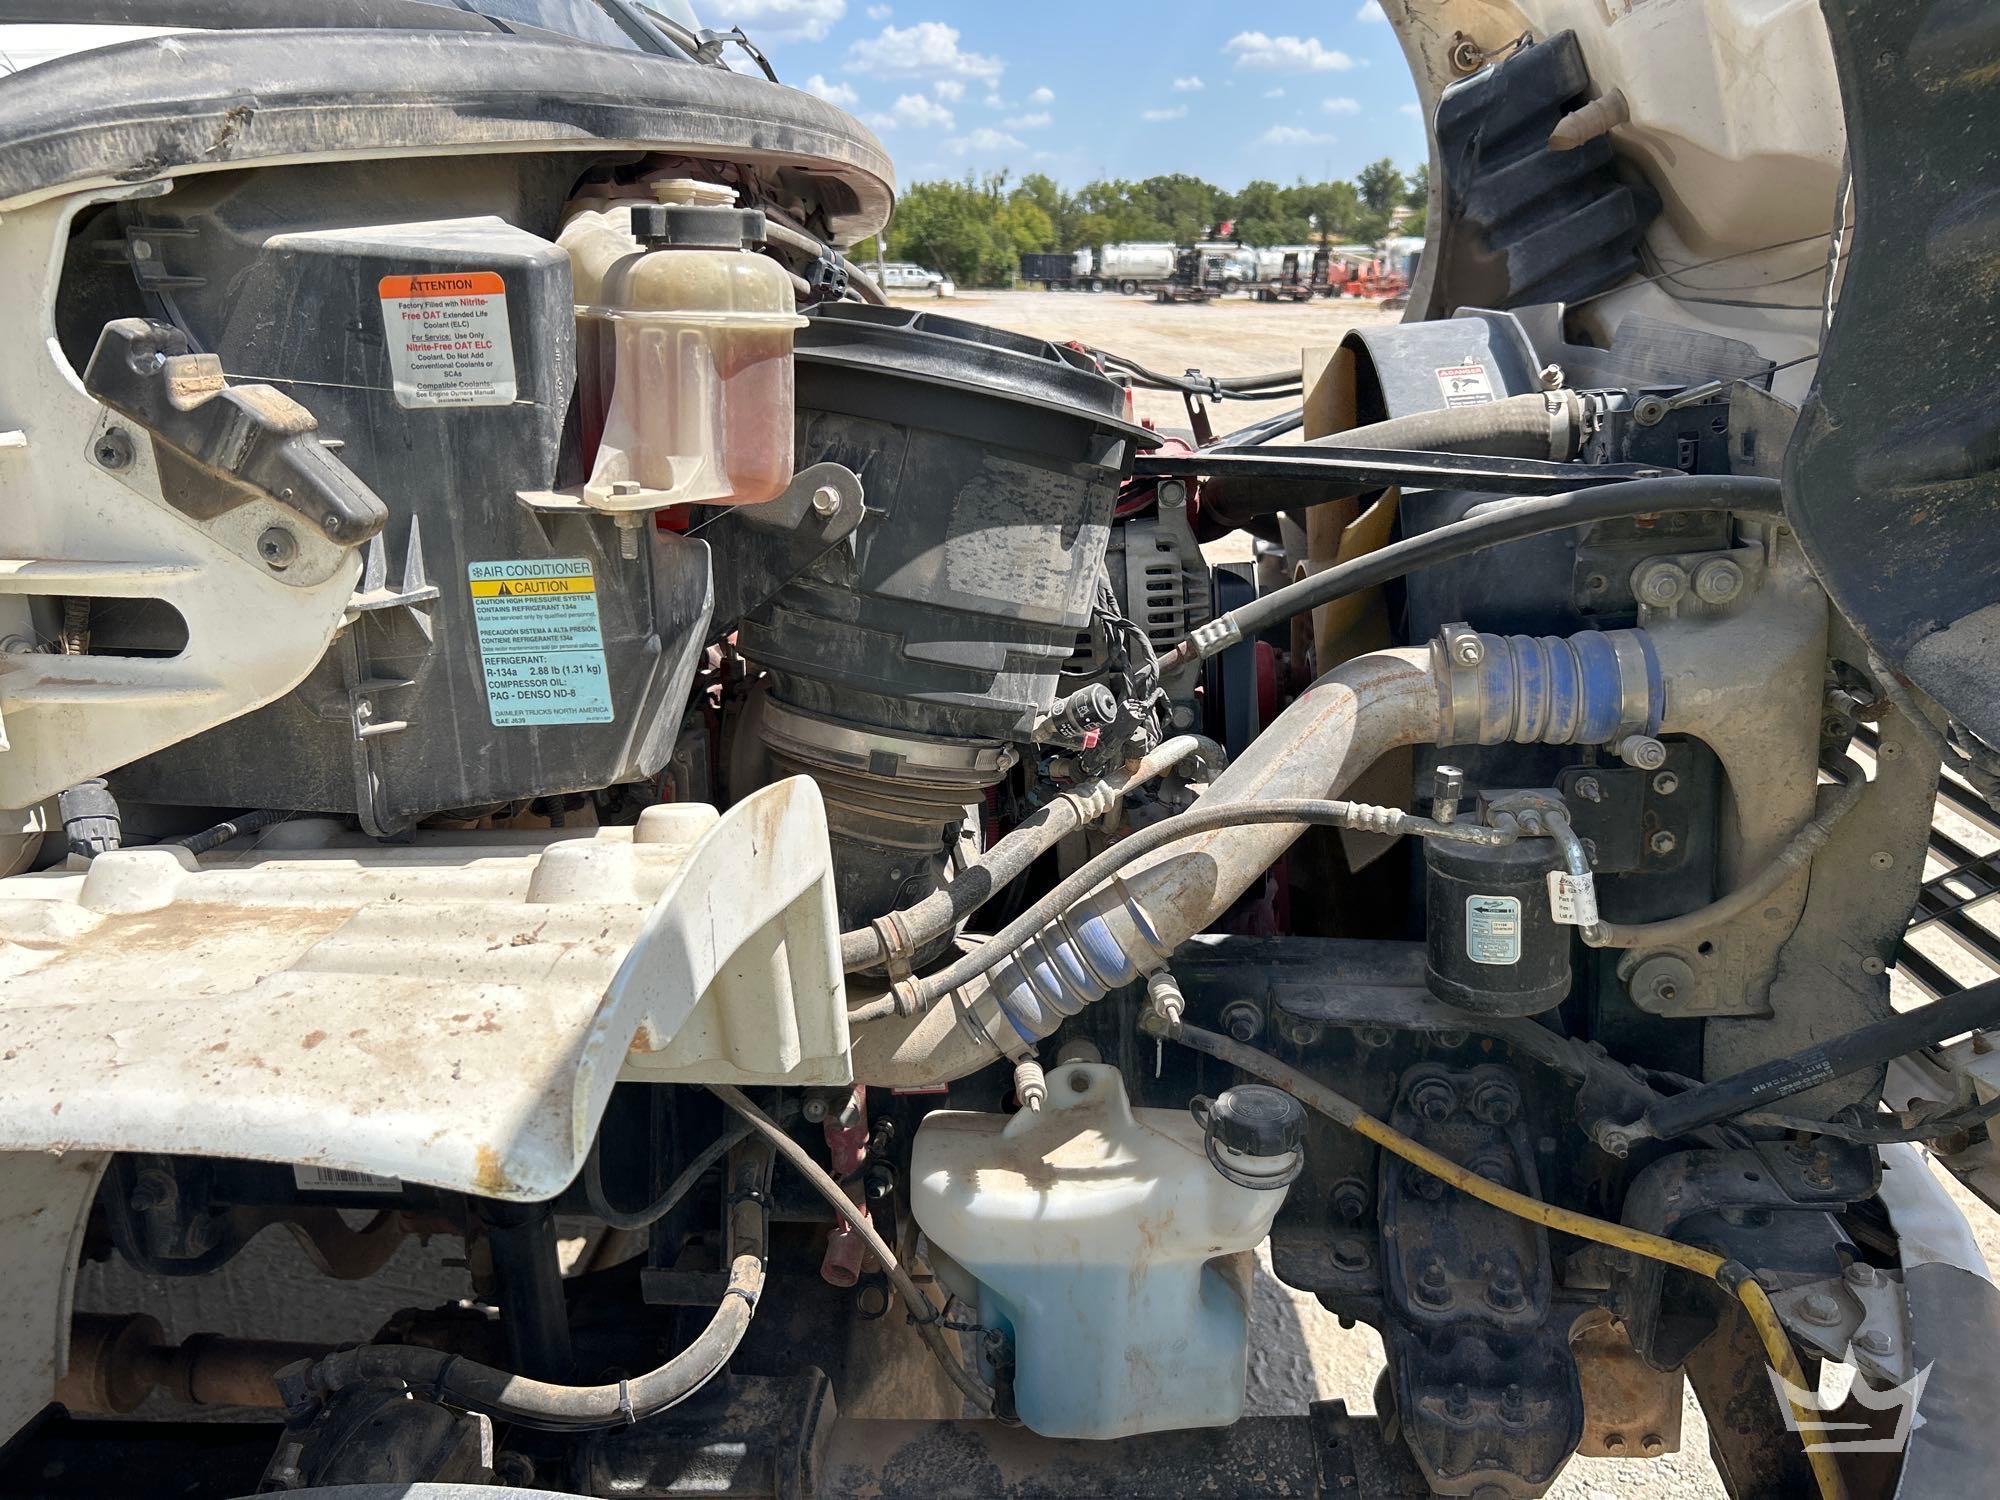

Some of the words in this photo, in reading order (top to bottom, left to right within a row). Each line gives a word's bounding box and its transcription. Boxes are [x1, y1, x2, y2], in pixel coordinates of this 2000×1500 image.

[409, 280, 473, 292] ATTENTION
[398, 302, 424, 310] Factory
[459, 298, 488, 306] Nitrite-
[402, 312, 421, 320] Free
[422, 311, 441, 319] OAT
[450, 320, 470, 329] (ELC)
[469, 332, 484, 340] Only
[406, 343, 452, 352] Nitrite-Free
[454, 342, 472, 350] OAT
[475, 341, 492, 349] ELC
[411, 362, 454, 370] Conventional
[455, 361, 484, 369] Coolants
[1448, 368, 1482, 376] DANGER
[416, 382, 457, 390] Compatible
[483, 566, 503, 577] AIR
[505, 562, 590, 577] CONDITIONER
[514, 580, 569, 594] CAUTION
[484, 656, 547, 666] REFRIGERANT:
[487, 668, 518, 677] R-134a
[529, 667, 549, 676] 2.88
[551, 666, 560, 675] lb
[562, 665, 584, 676] (1.31
[586, 664, 601, 675] kg)
[488, 680, 548, 689] COMPRESSOR
[550, 678, 567, 687] OIL:
[490, 691, 509, 700] PAG
[517, 690, 550, 699] DENSO
[553, 689, 576, 698] ND-8
[526, 708, 552, 716] TRUCKS
[553, 707, 577, 715] NORTH
[578, 706, 609, 714] AMERICA
